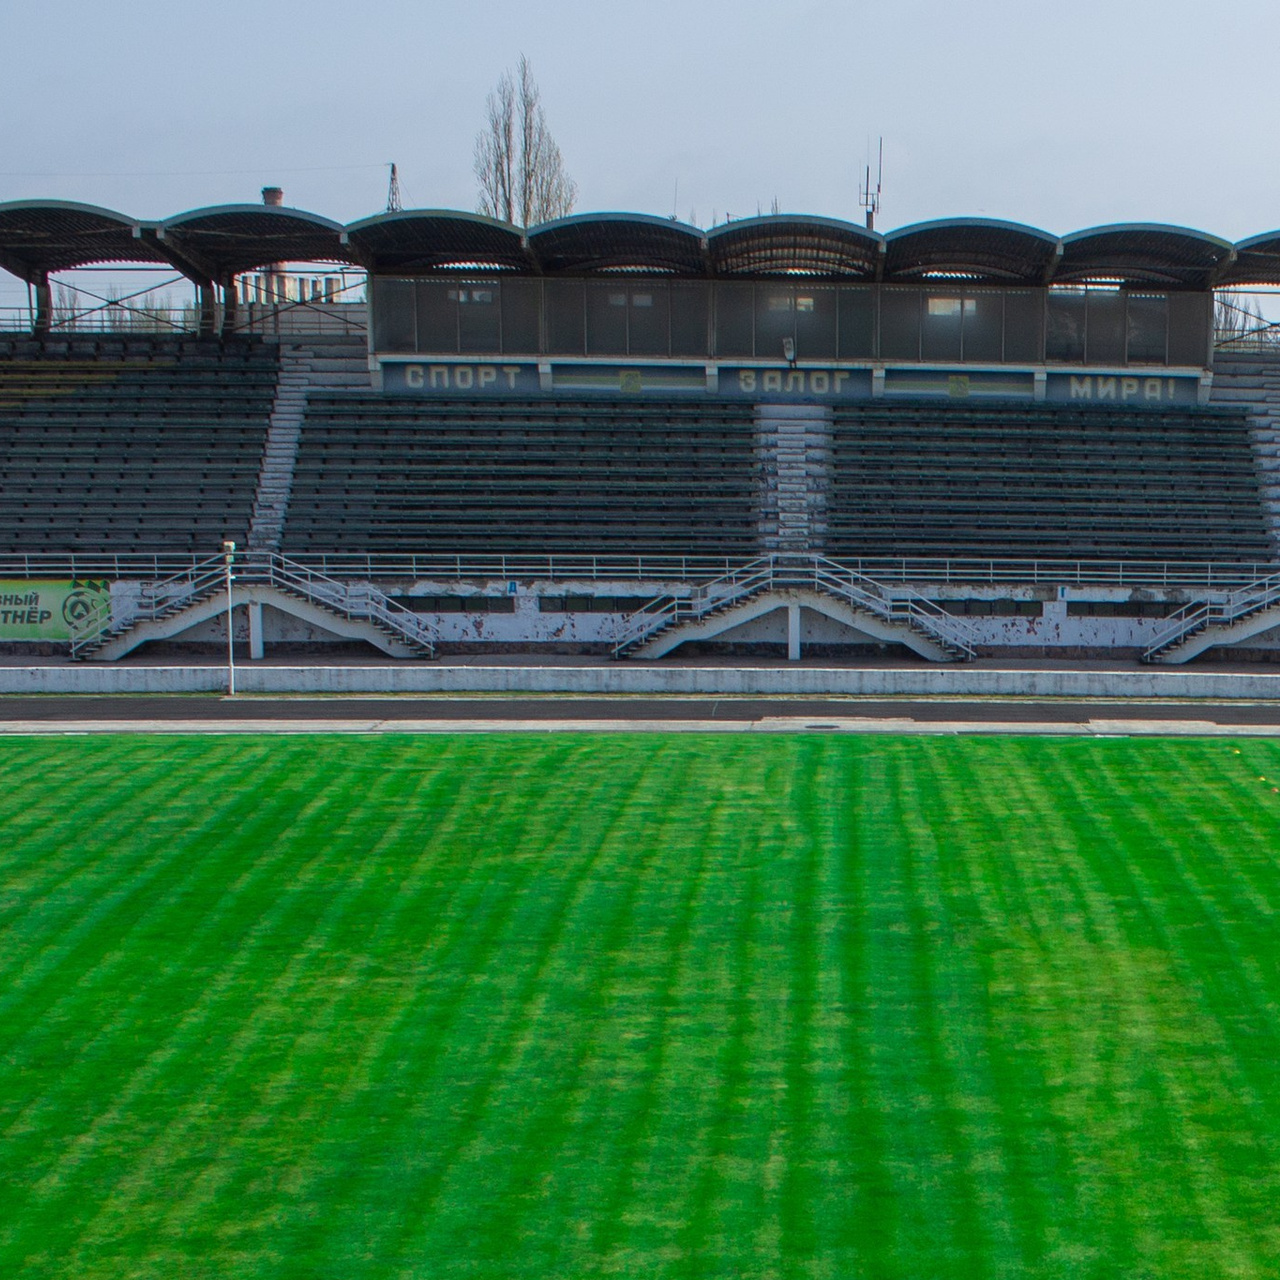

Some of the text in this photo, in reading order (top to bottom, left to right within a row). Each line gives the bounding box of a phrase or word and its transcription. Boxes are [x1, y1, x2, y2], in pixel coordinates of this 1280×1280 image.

[405, 365, 1175, 400] СПОРТ ЗАЛОГ МИРА!
[0, 592, 39, 606] НЫЙ
